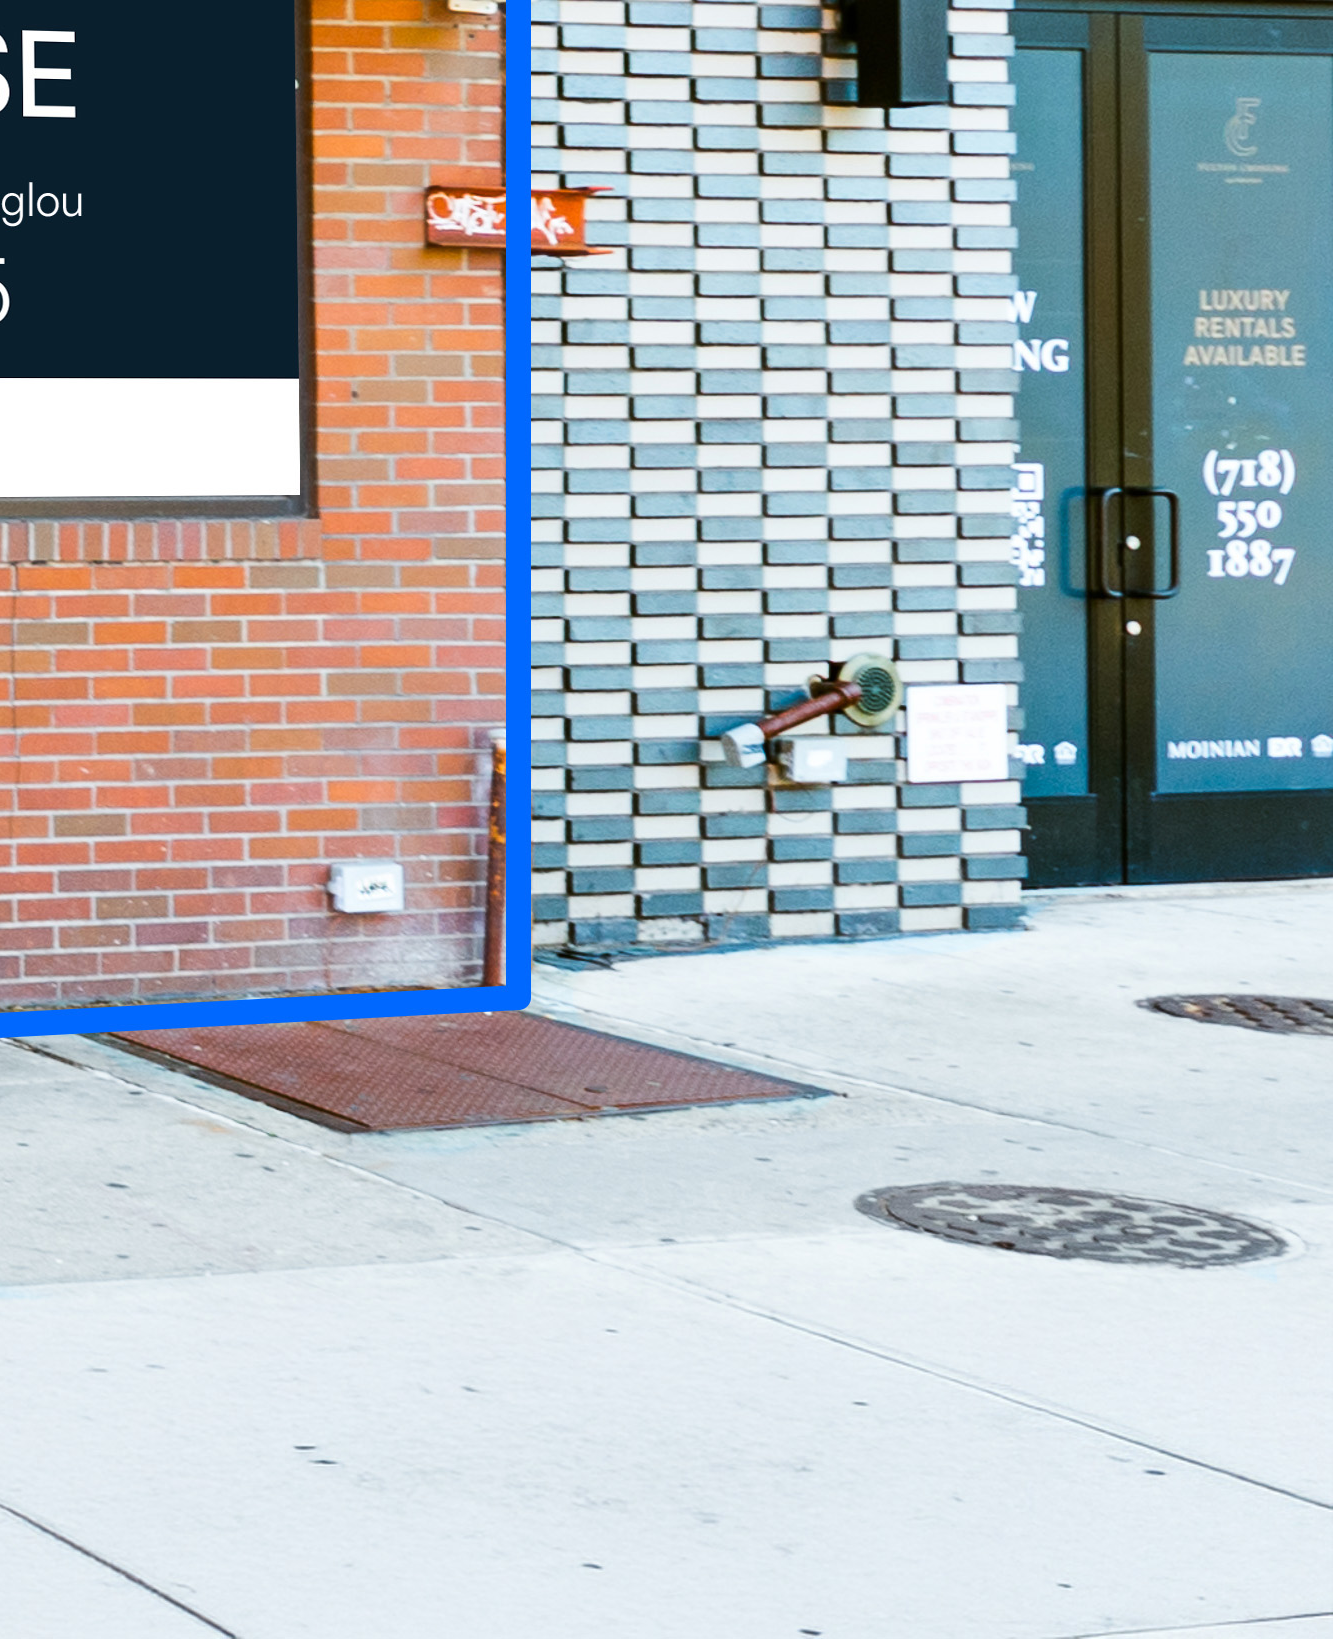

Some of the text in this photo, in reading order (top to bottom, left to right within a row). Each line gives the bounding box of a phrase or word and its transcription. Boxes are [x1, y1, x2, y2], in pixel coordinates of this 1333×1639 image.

[1199, 289, 1290, 311] LUXURY
[1194, 317, 1296, 338] RENTALS
[1013, 339, 1070, 372] NG
[1184, 345, 1306, 366] AVAILABLE
[1203, 449, 1296, 496] (718)
[1217, 500, 1282, 538] 550
[1206, 539, 1296, 586] 1887
[1167, 739, 1260, 759] MOINIAN
